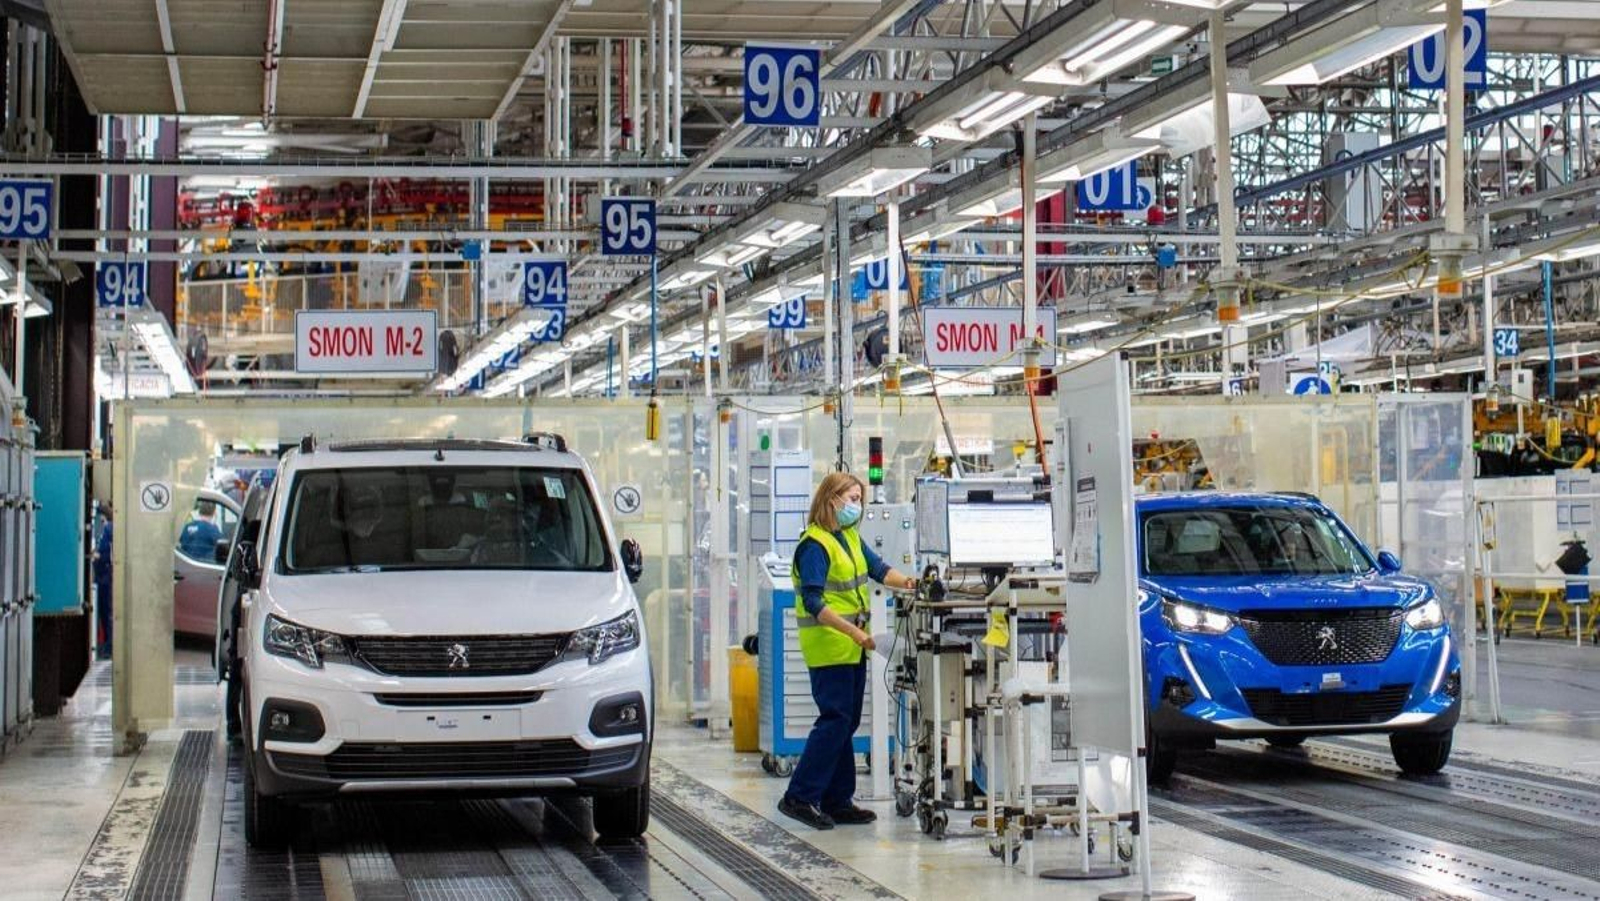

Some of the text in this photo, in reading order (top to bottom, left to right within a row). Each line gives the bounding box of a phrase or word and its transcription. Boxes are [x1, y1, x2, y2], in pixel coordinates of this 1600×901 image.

[748, 53, 815, 119] 96
[1085, 163, 1131, 206] 01
[0, 187, 47, 235] 95
[606, 203, 652, 250] 95
[104, 265, 140, 302] 94
[527, 266, 566, 302] 94
[771, 297, 804, 326] 99
[309, 326, 423, 357] SMON M-2
[936, 323, 997, 352] SMON
[1495, 330, 1517, 355] 34
